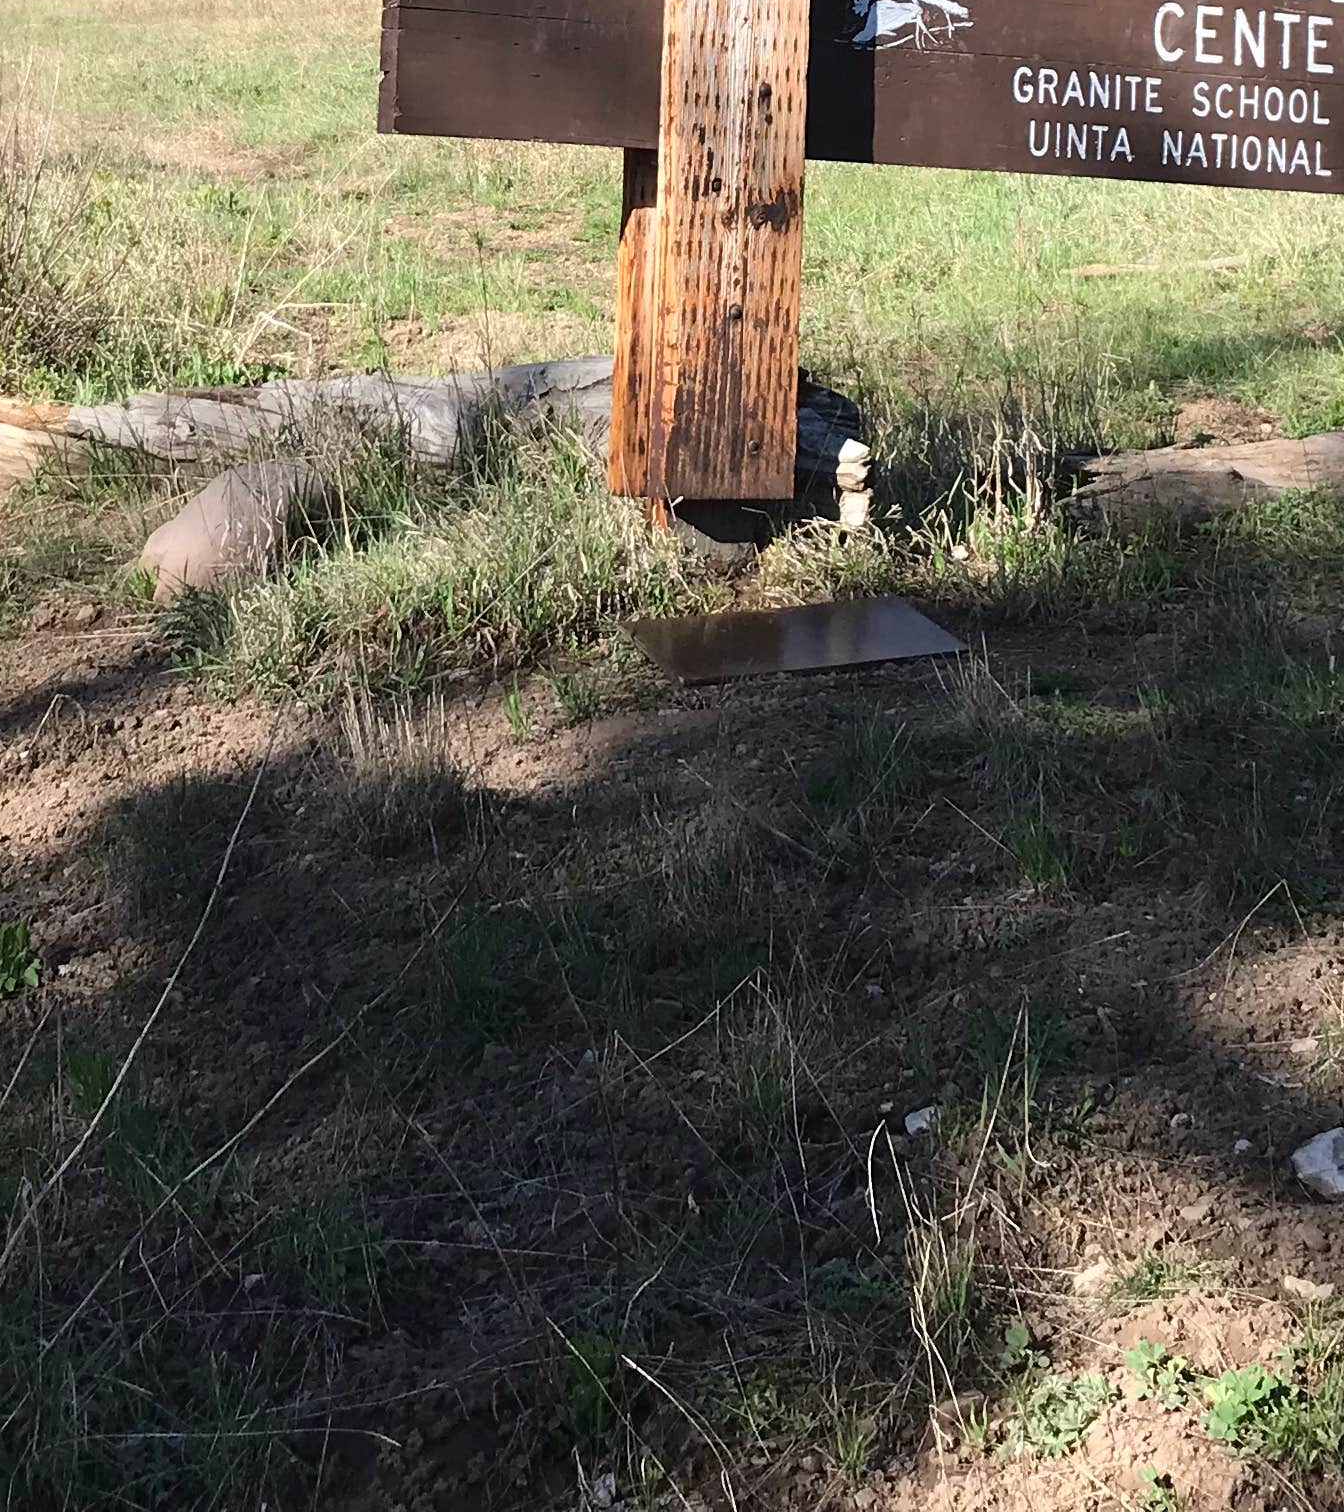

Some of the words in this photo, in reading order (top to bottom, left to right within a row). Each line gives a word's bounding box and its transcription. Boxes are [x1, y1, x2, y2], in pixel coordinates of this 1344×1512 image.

[1013, 67, 1163, 114] GRANITE
[1192, 80, 1334, 126] SCHOOL
[1028, 120, 1133, 163] UINTA
[1162, 130, 1333, 177] NATIONAL
